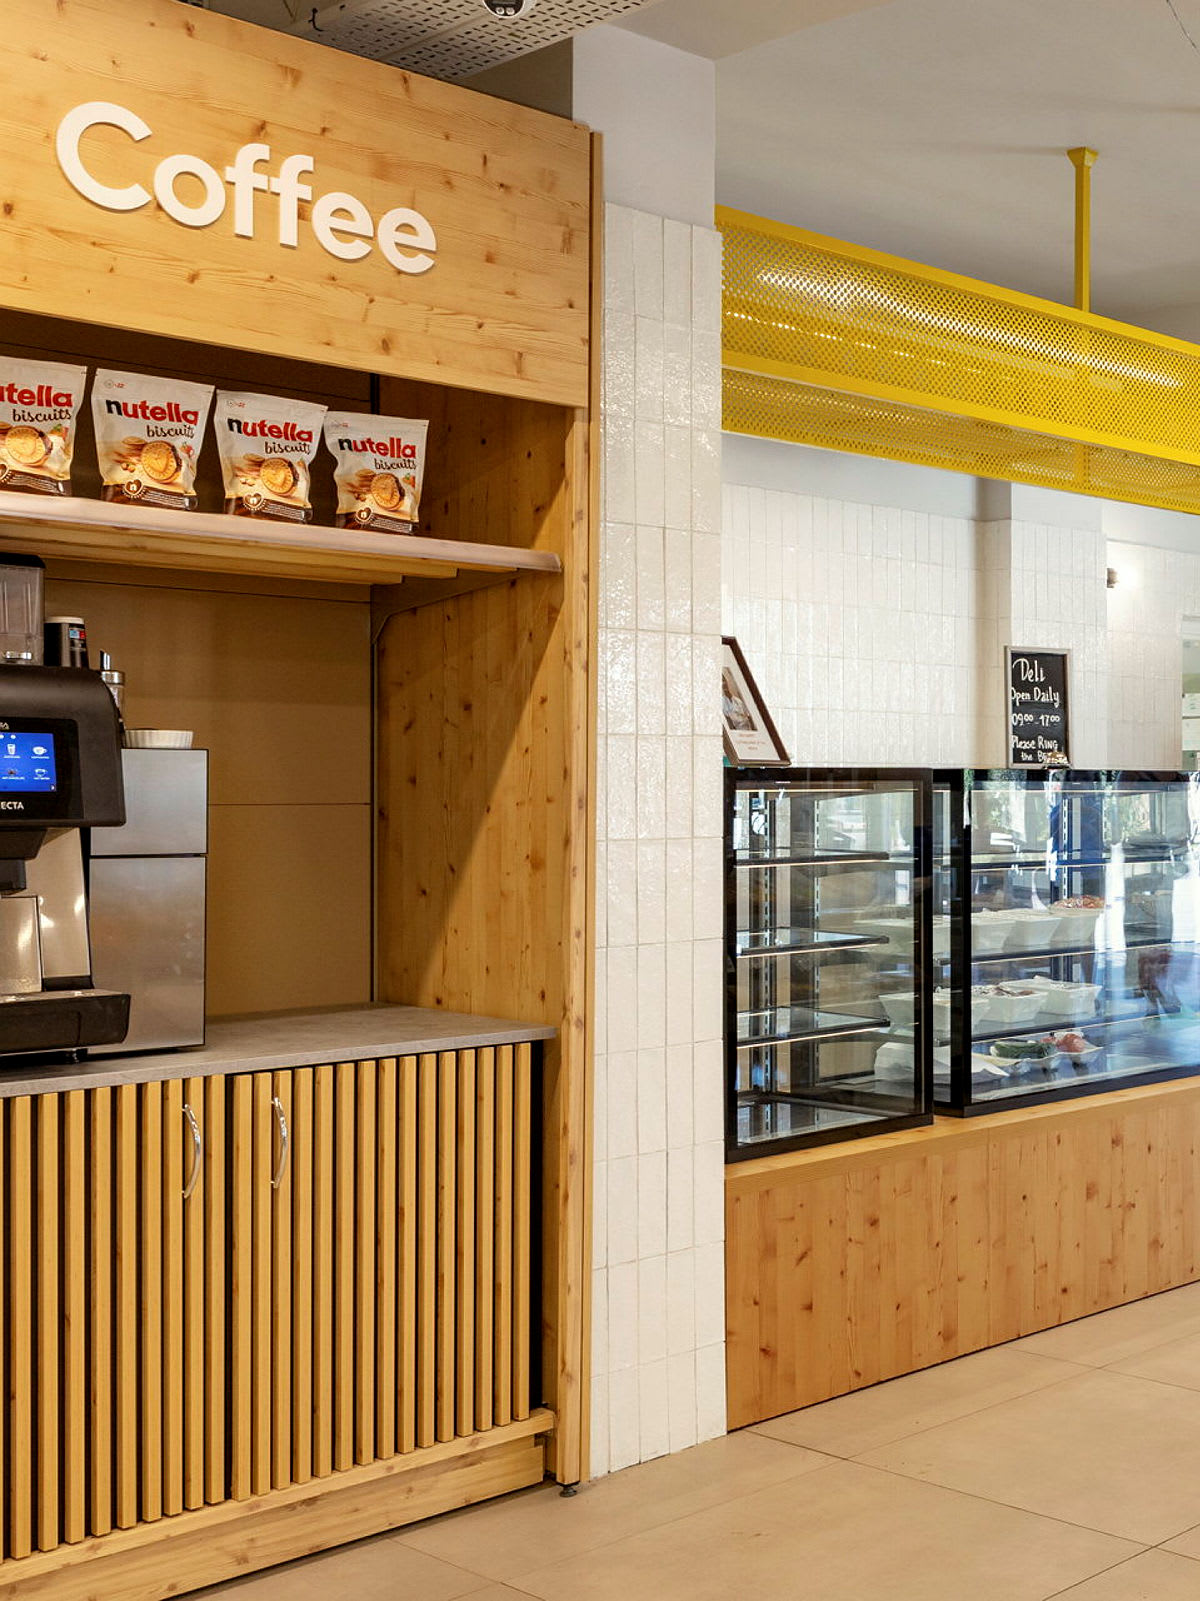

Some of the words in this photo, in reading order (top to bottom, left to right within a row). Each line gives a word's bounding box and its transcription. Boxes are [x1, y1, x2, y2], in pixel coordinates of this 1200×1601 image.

[56, 101, 437, 274] Coffee
[12, 408, 72, 422] biscuits
[106, 399, 199, 426] nutella
[146, 424, 195, 439] biscuits
[227, 417, 313, 443] nutella
[338, 436, 416, 459] nutella
[374, 458, 416, 470] biscuits
[1012, 658, 1046, 682] Deli
[1011, 687, 1030, 706] Open
[1034, 686, 1059, 708] Daily
[1011, 735, 1036, 749] Please
[1021, 750, 1033, 761] the
